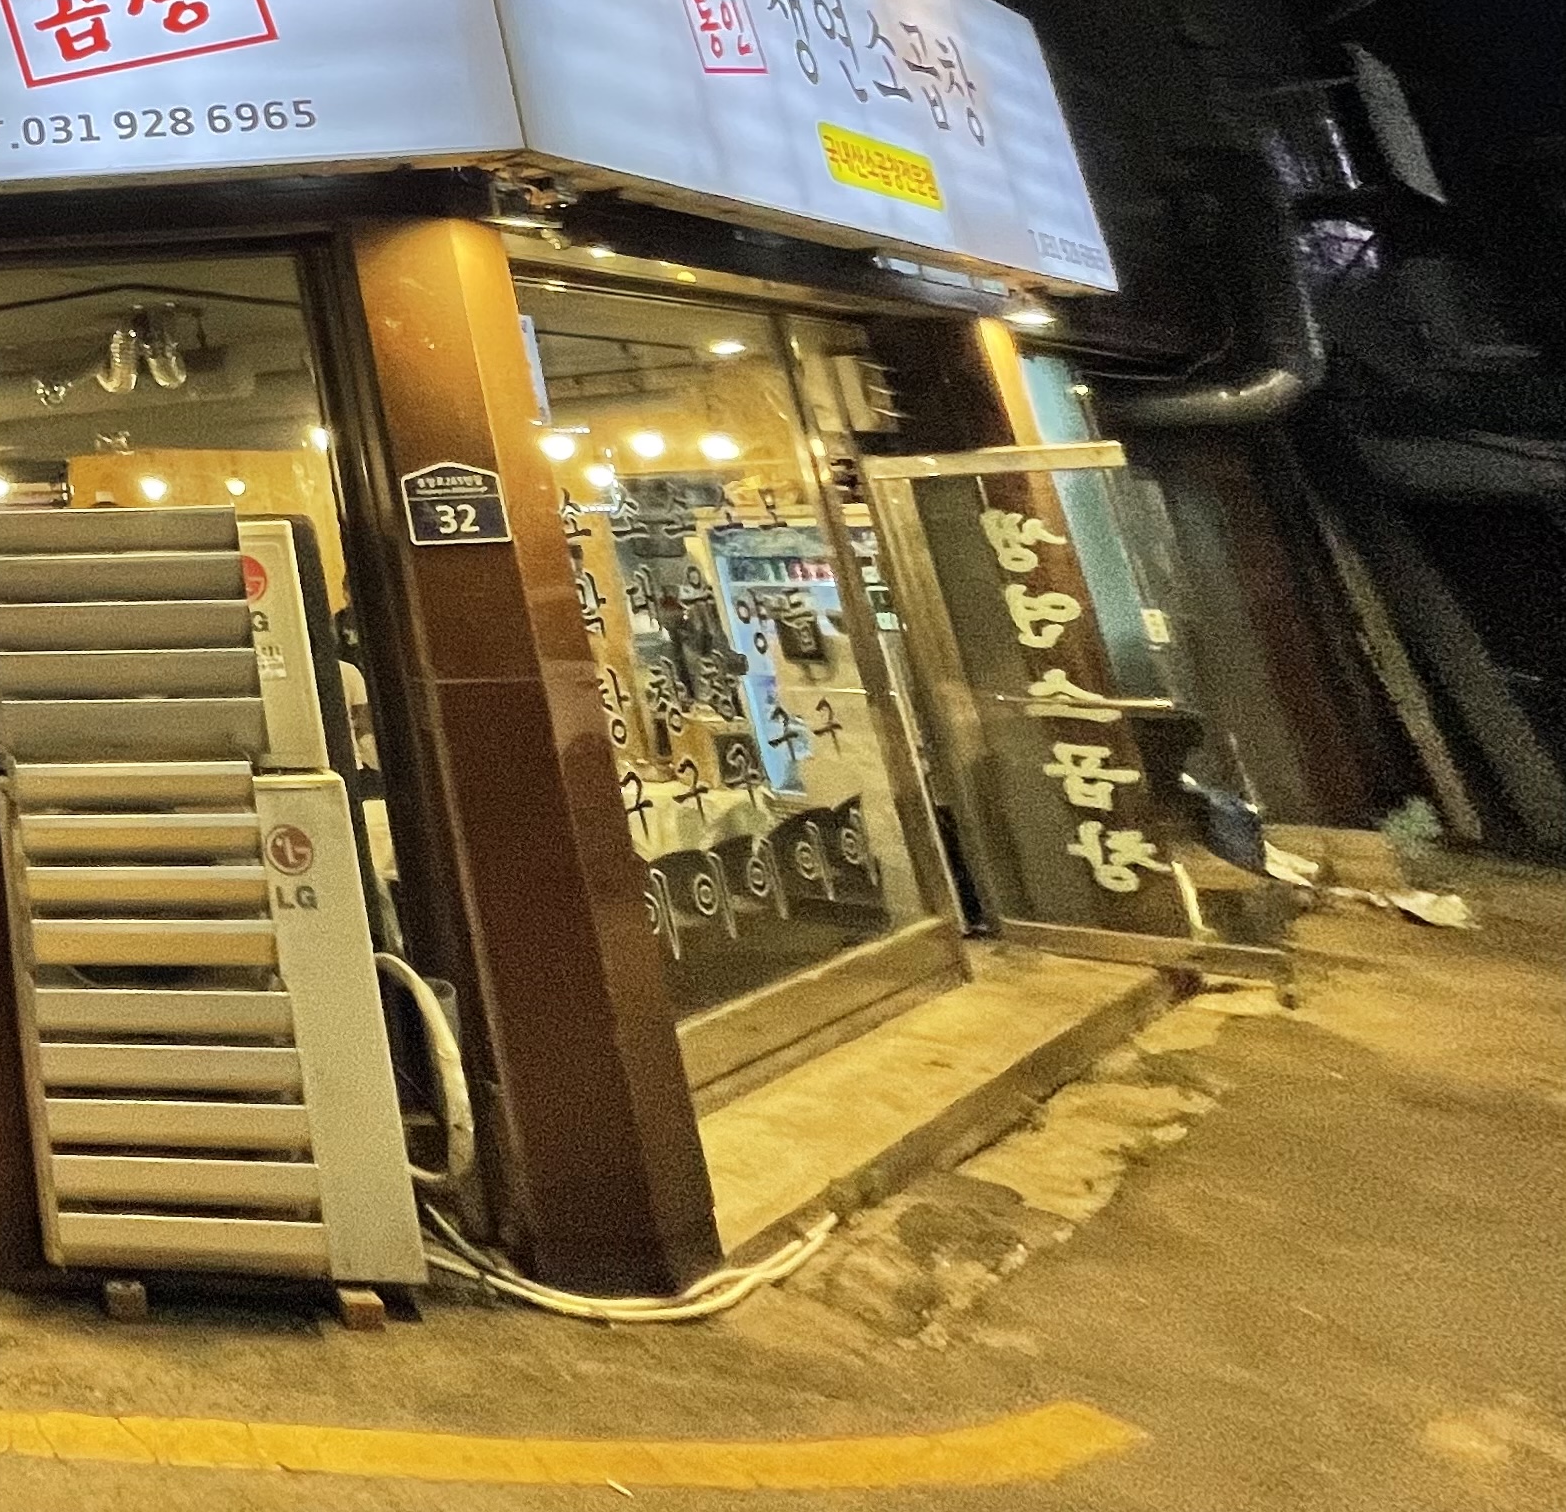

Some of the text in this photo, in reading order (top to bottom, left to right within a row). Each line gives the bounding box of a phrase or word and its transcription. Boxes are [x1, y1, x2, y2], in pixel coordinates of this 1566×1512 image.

[116, 107, 196, 141] 928
[206, 98, 318, 134] 6965
[435, 503, 481, 535] 32
[277, 885, 318, 911] LG
